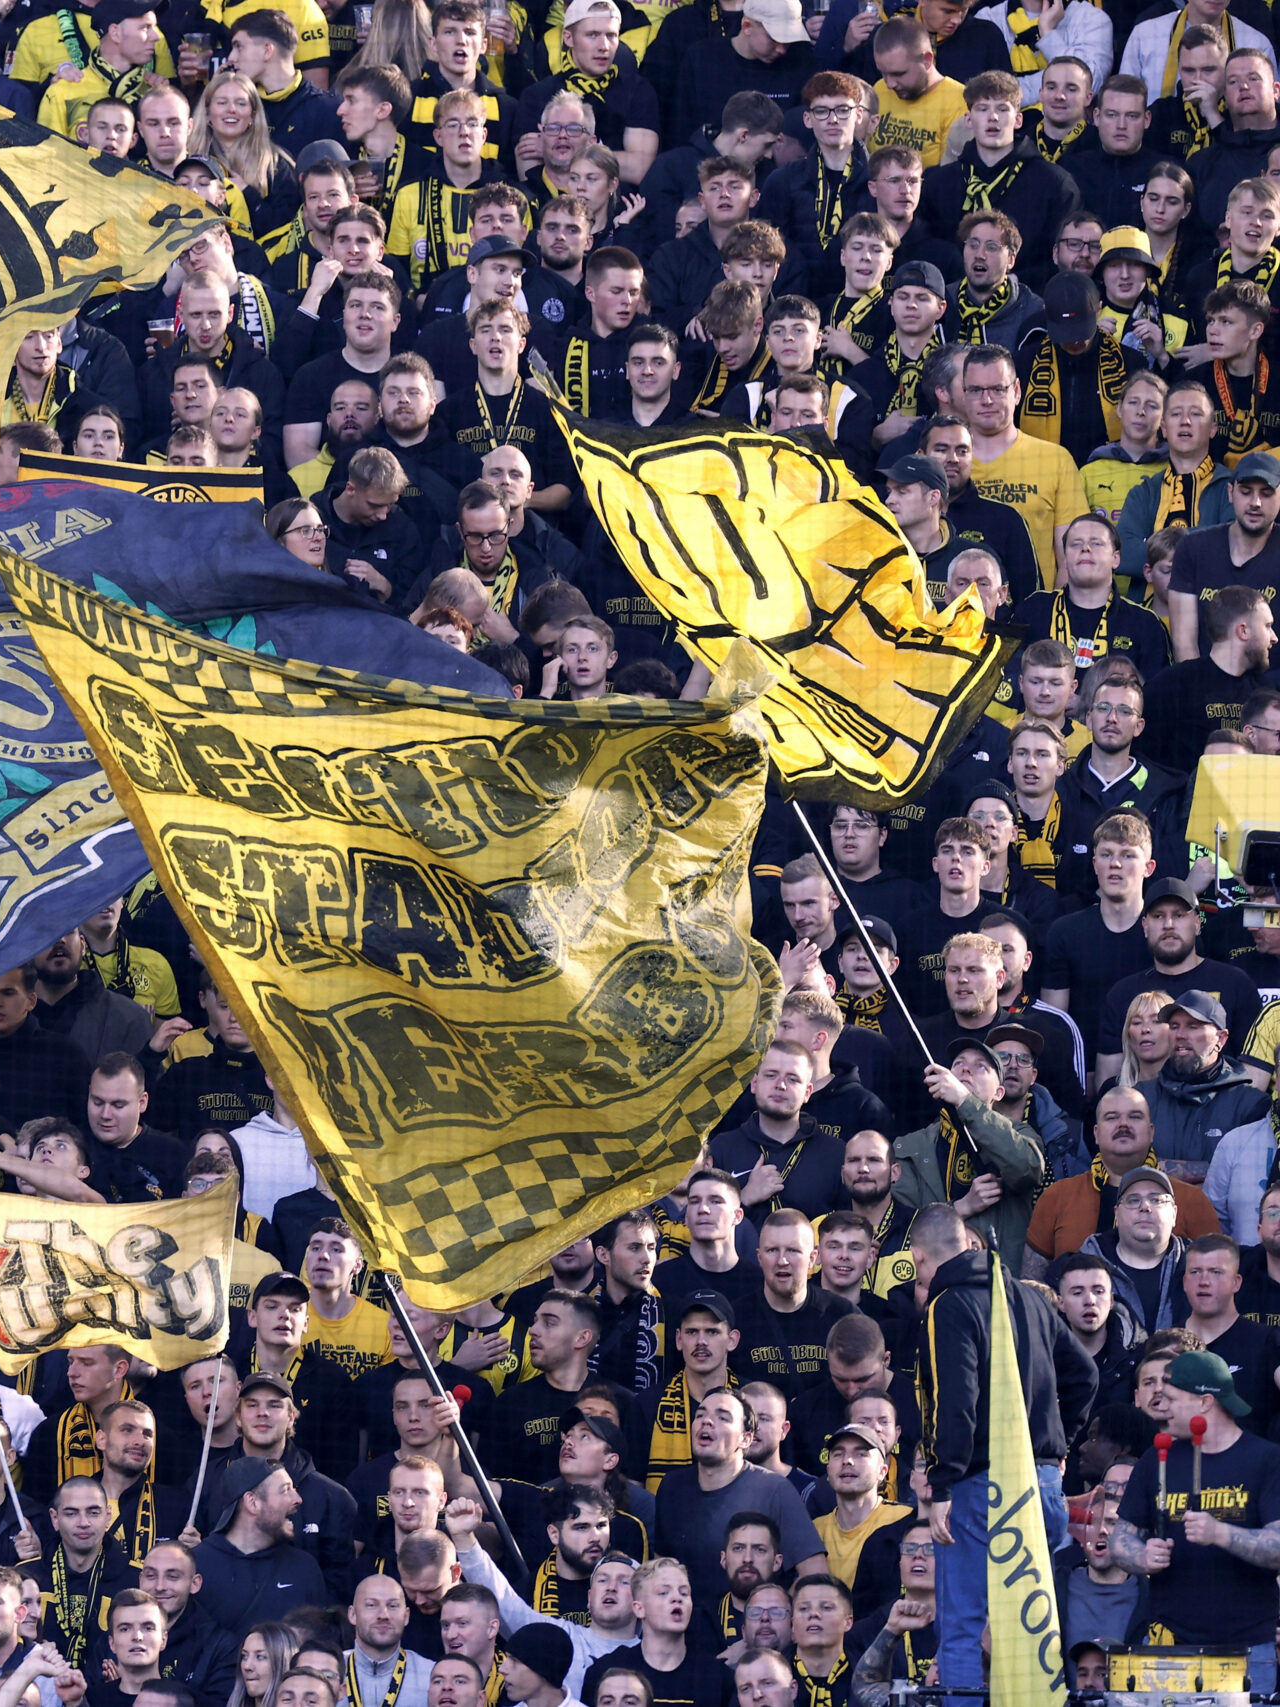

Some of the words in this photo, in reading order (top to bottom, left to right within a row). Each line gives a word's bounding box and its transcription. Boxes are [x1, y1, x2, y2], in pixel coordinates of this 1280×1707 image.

[301, 28, 324, 42] GLS
[432, 222, 443, 244] WIR
[977, 484, 1038, 498] STFALEN
[23, 785, 115, 851] sinc
[4, 1219, 179, 1286] The
[895, 1261, 911, 1274] BVB
